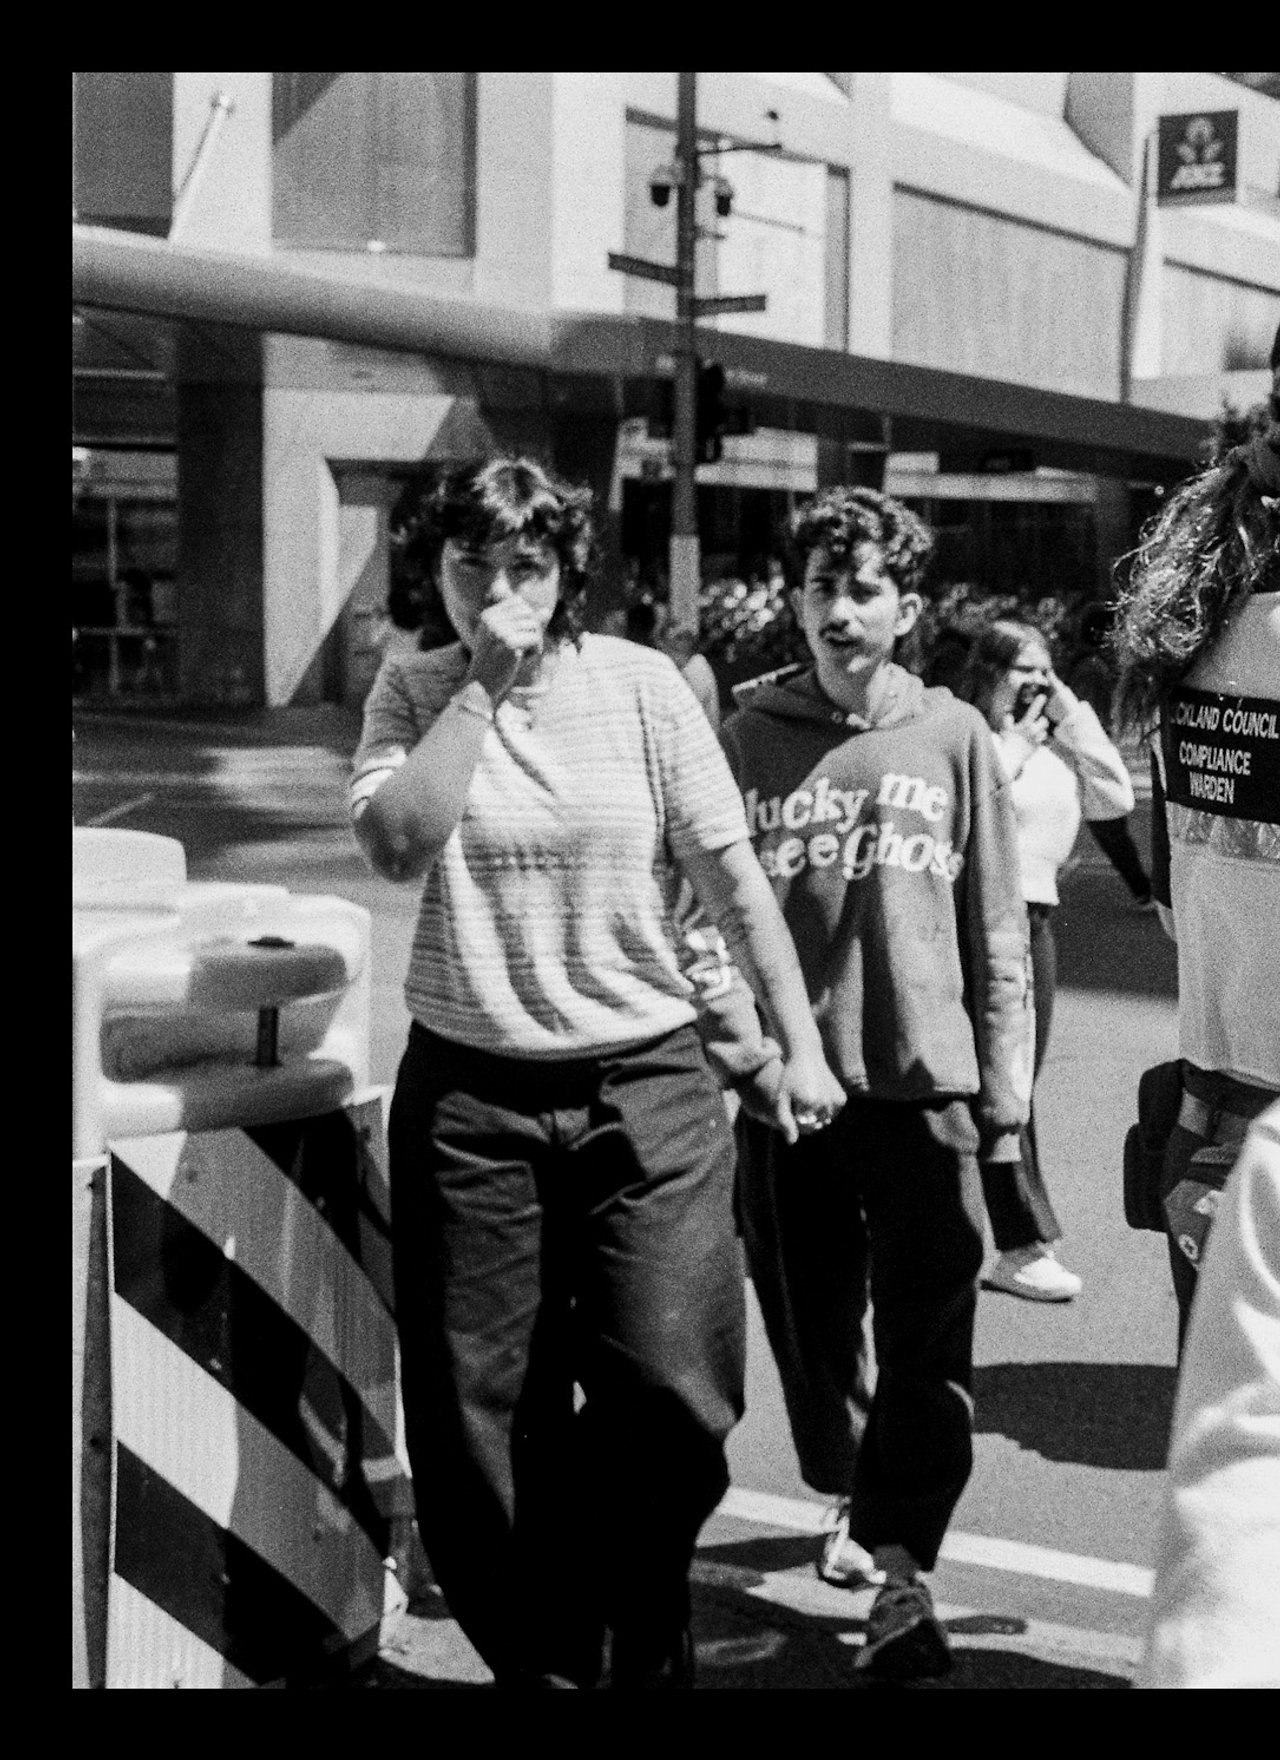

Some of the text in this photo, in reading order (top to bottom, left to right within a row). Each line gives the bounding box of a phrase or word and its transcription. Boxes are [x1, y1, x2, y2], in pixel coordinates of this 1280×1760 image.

[1171, 702, 1280, 739] CKLAND COUNCIL
[1179, 740, 1252, 775] COMPLIANCE
[744, 773, 949, 838] lucky me
[1189, 771, 1236, 804] WARDEN
